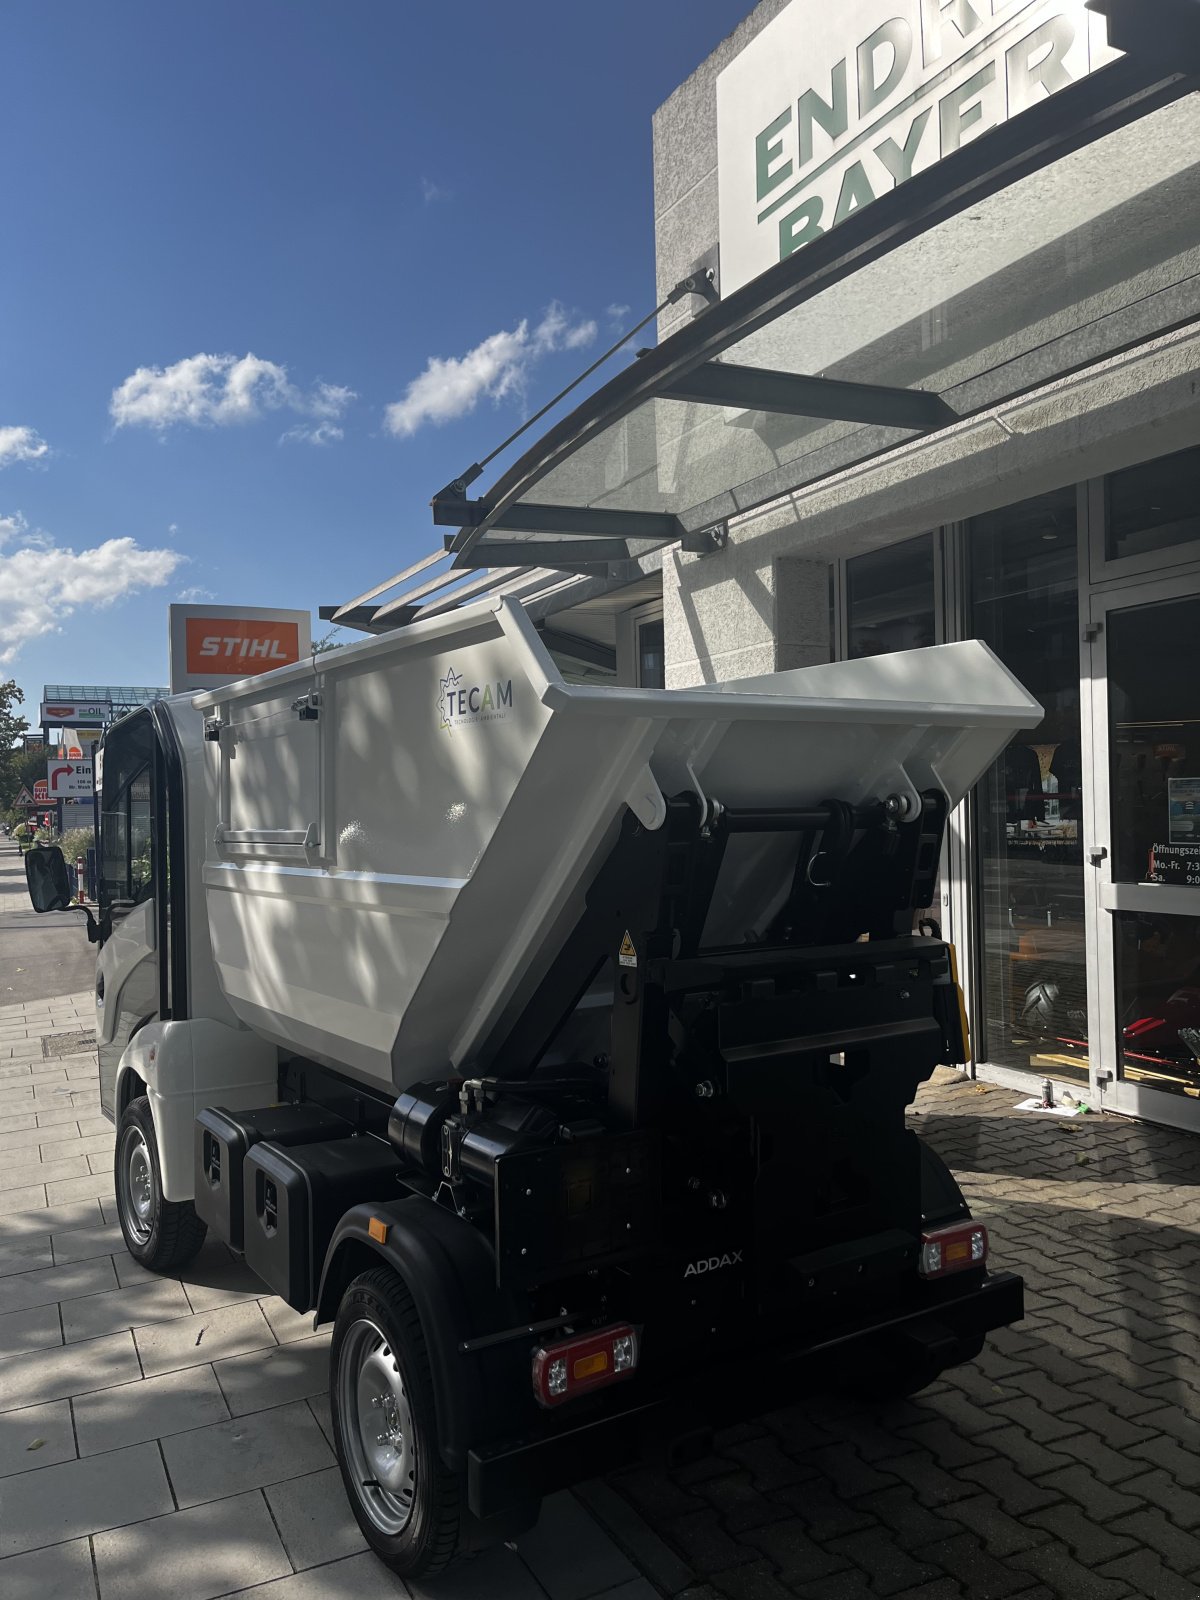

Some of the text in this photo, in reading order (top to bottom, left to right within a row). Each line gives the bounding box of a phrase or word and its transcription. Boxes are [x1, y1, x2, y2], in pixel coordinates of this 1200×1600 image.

[756, 0, 1012, 202] ENDR
[779, 9, 1110, 262] BAYER
[199, 636, 287, 659] STIHL
[446, 680, 513, 717] TECAM
[76, 765, 92, 774] Ein
[684, 1250, 743, 1278] ADDAX
